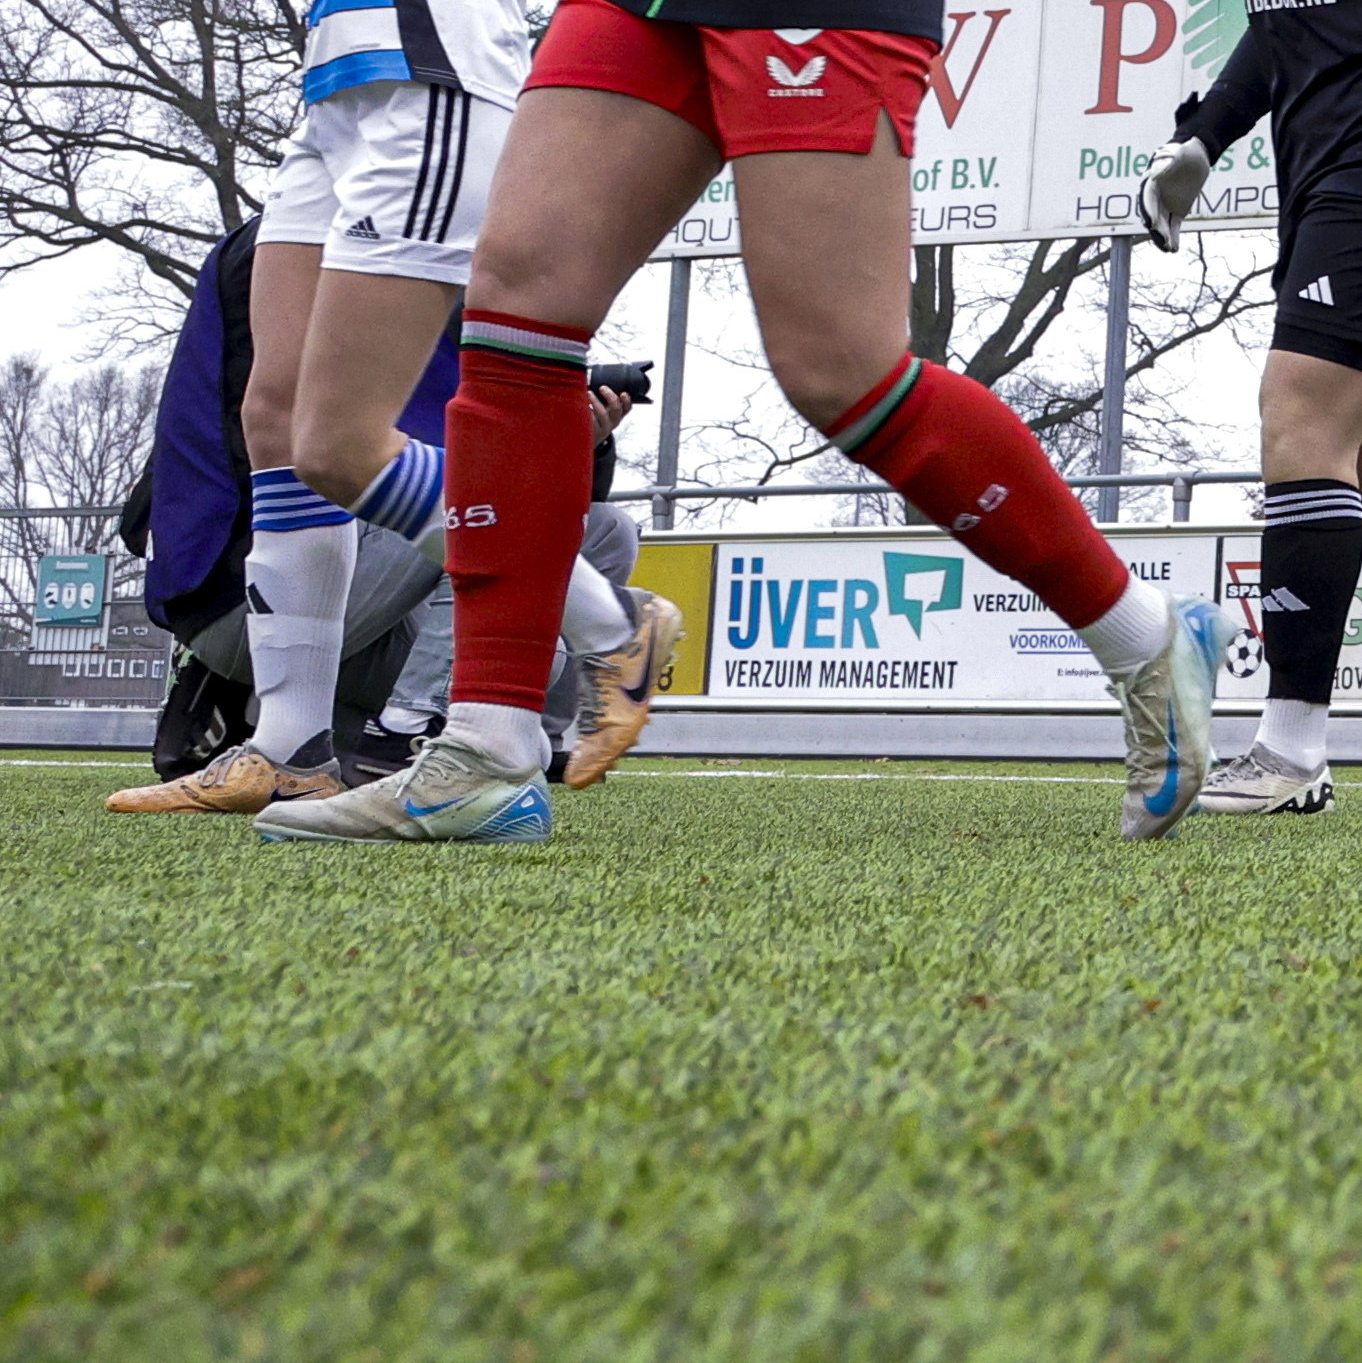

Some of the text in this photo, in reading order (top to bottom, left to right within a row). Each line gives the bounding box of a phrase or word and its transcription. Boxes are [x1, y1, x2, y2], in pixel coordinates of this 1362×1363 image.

[1247, 136, 1271, 170] &
[912, 157, 1000, 201] of B.V.
[725, 660, 958, 689] VERZUIM MANAGEMENT
